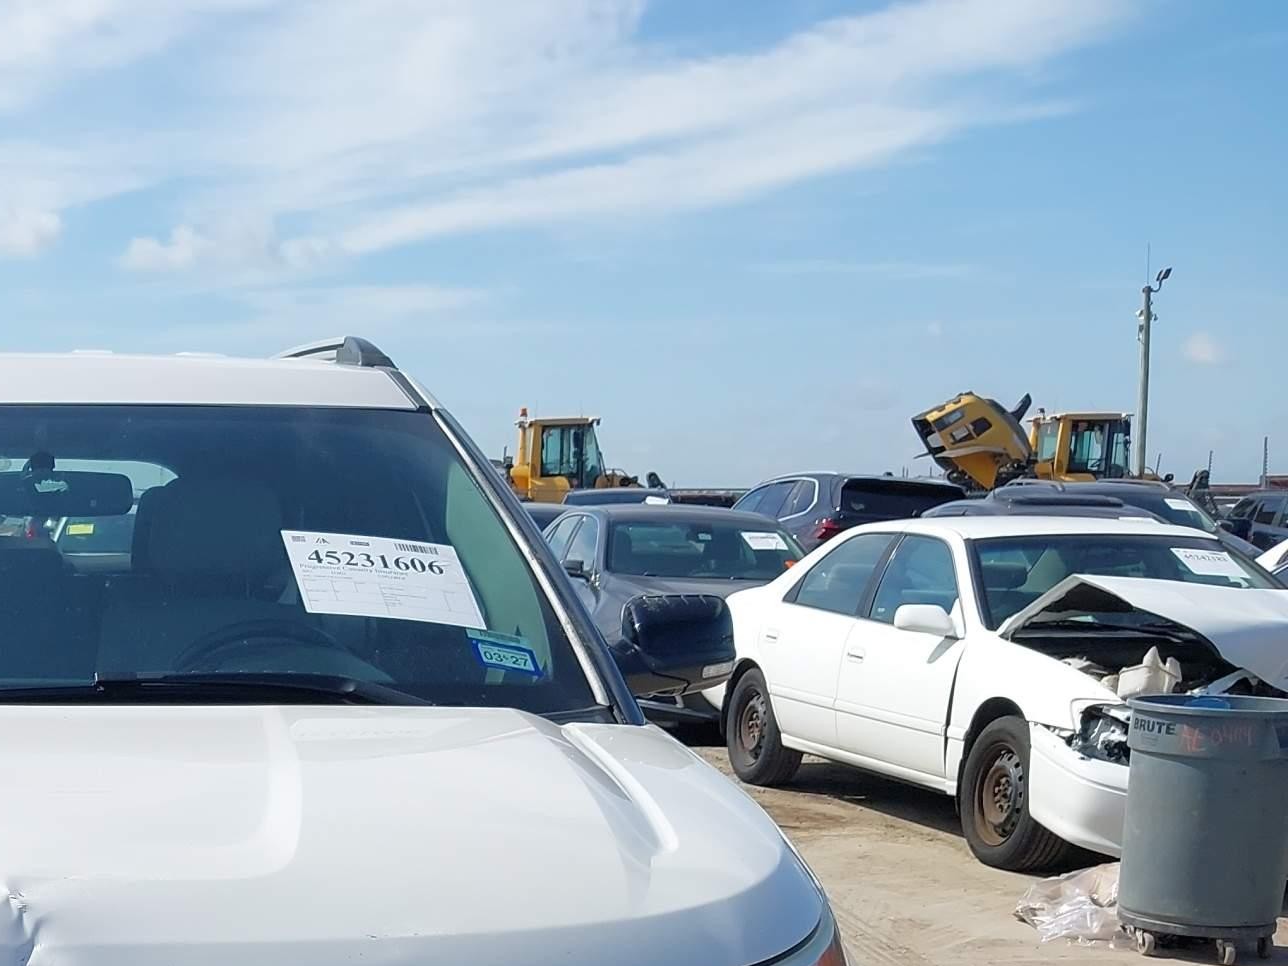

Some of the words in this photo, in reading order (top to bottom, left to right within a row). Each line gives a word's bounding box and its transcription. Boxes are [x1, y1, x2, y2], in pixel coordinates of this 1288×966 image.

[307, 549, 445, 576] 45231606
[510, 655, 529, 667] 27
[1133, 716, 1177, 735] BRUTE
